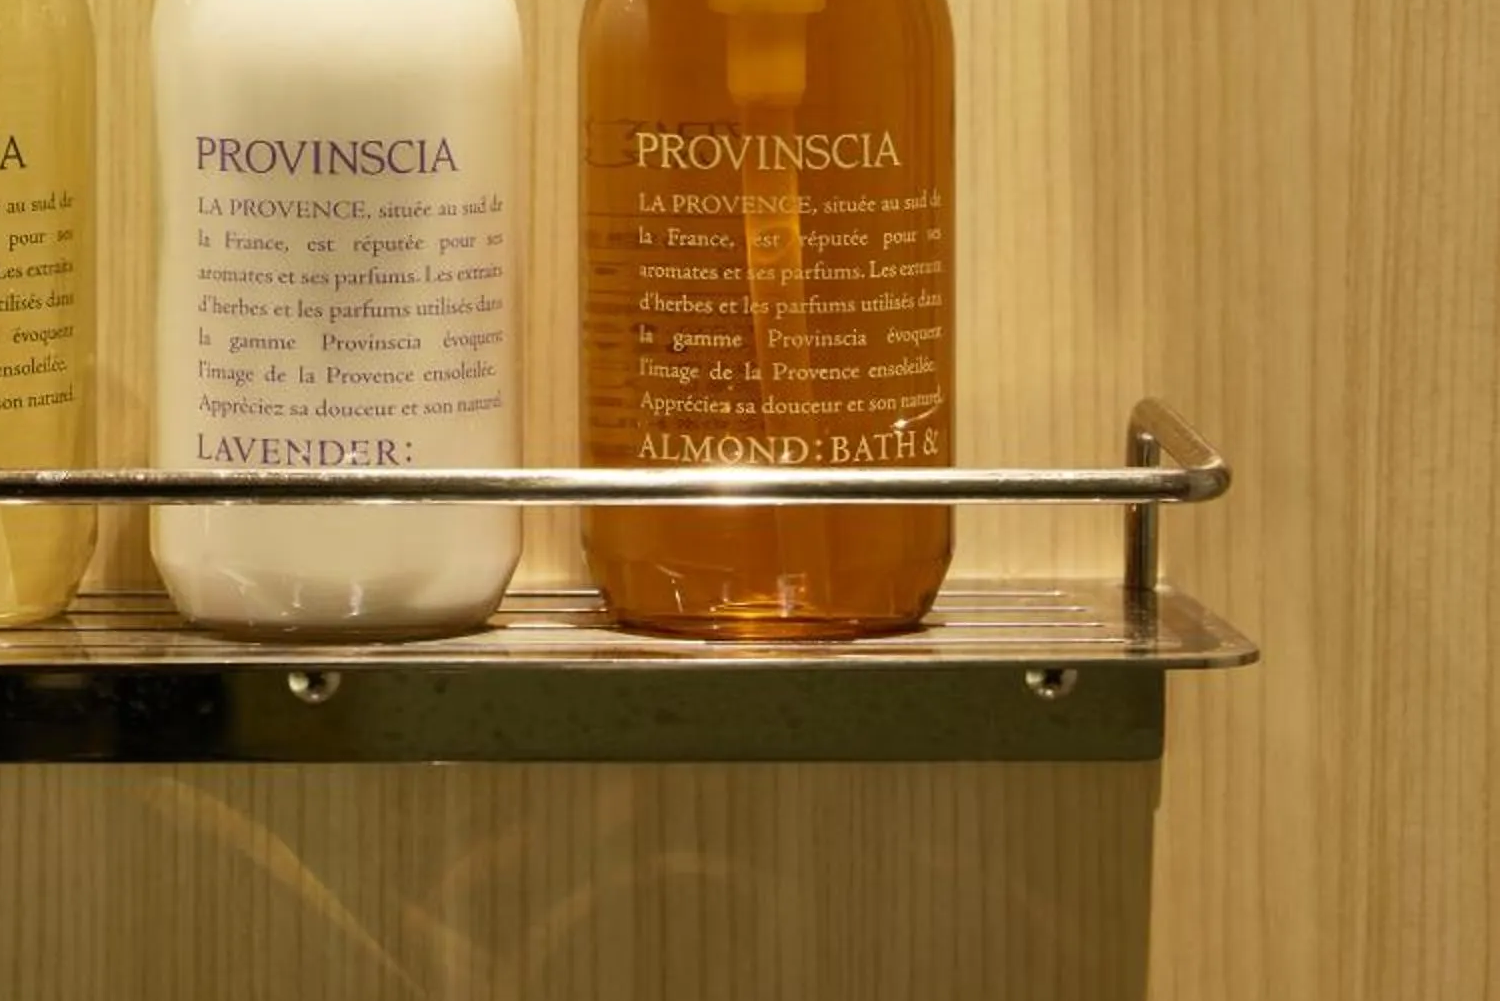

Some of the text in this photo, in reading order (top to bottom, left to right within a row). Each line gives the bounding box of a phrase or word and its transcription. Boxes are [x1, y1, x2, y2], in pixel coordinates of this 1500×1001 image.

[196, 136, 458, 175] PROVINSCIA
[636, 131, 901, 170] PROVINSCIA
[6, 199, 26, 214] au
[31, 193, 56, 212] sud
[198, 197, 222, 215] LA
[230, 198, 371, 220] PROVENCE,
[379, 200, 431, 218] située
[438, 202, 457, 217] au
[463, 195, 486, 214] sud
[640, 193, 666, 214] LA
[673, 194, 817, 216] PROVENCE,
[824, 193, 876, 214] située
[881, 196, 899, 211] au
[904, 190, 927, 210] sud
[8, 232, 45, 255] pour
[198, 229, 211, 247] la
[225, 231, 289, 253] France,
[307, 238, 335, 253] est
[353, 235, 424, 257] réputée
[439, 234, 476, 256] pour
[639, 227, 652, 245] la
[668, 229, 735, 248] France,
[753, 234, 779, 247] est
[800, 230, 869, 252] réputée
[883, 230, 917, 250] pour
[198, 267, 273, 284] aromates
[278, 270, 294, 284] et
[301, 272, 329, 285] ses
[335, 266, 421, 290] parfums.
[425, 265, 453, 282] Les
[640, 264, 718, 280] aromates
[724, 265, 741, 280] et
[747, 268, 775, 280] ses
[781, 261, 865, 285] parfums.
[870, 261, 896, 279] Les
[198, 295, 268, 317] d'herbes
[274, 303, 291, 317] et
[298, 299, 322, 318] les
[330, 298, 411, 324] parfums
[416, 295, 474, 316] utilisés
[640, 292, 712, 315] d'herbes
[719, 300, 737, 315] et
[744, 297, 769, 315] les
[776, 293, 855, 319] parfums
[861, 290, 914, 312] utilisés
[199, 327, 211, 346] la
[230, 335, 295, 353] gamme
[322, 334, 421, 352] Provinscia
[640, 325, 653, 343] la
[673, 331, 742, 351] gamme
[768, 329, 867, 347] Provinscia
[199, 360, 254, 384] l'image
[265, 364, 286, 383] de
[299, 365, 315, 384] la
[327, 366, 414, 384] Provence
[640, 359, 700, 383] l'image
[710, 364, 732, 380] de
[745, 363, 761, 380] la
[773, 364, 860, 381] Provence
[198, 393, 284, 418] Appréciez
[290, 402, 308, 416] sa
[316, 398, 395, 417] douceur
[402, 400, 418, 415] et
[423, 399, 452, 415] son
[736, 399, 756, 414] sa
[762, 394, 841, 415] douceur
[847, 398, 863, 411] et
[869, 395, 896, 411] son
[197, 433, 413, 466] LAVENDER:
